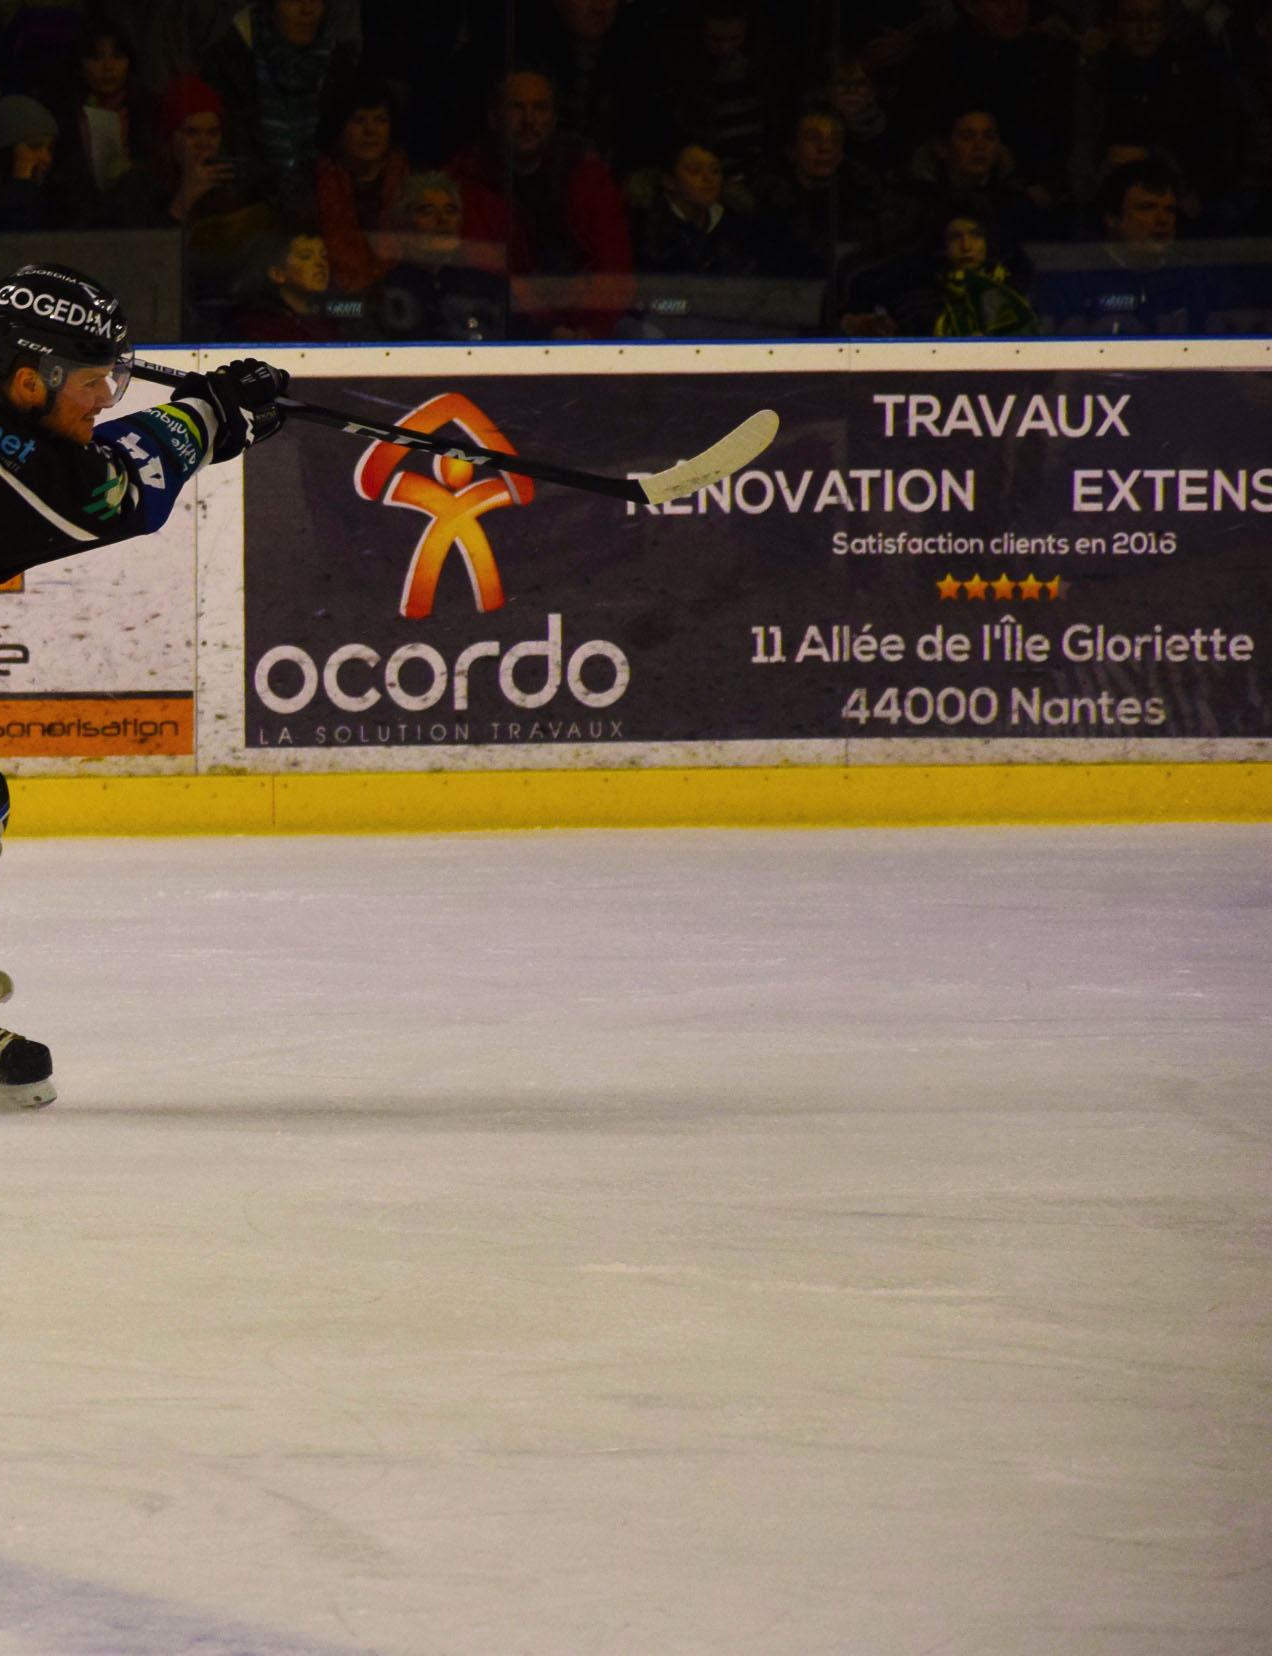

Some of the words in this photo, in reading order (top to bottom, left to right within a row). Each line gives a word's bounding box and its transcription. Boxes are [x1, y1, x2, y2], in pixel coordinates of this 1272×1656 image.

[874, 395, 1130, 437] TRAVAUX
[832, 532, 984, 556] Satisfaction
[990, 533, 1068, 555] clients
[1075, 539, 1106, 555] en
[1113, 533, 1177, 555] 2016
[751, 626, 786, 663] 11
[795, 623, 904, 663] Allée
[916, 625, 970, 662] de
[982, 616, 1050, 662] l'Île
[1062, 623, 1254, 662] Gloriette
[255, 613, 630, 714] ocordo
[841, 688, 998, 725] 44000
[1012, 687, 1167, 726] Nantes
[259, 727, 293, 745] LA
[315, 723, 470, 743] SOLUTION
[491, 720, 624, 741] TRAVAUX
